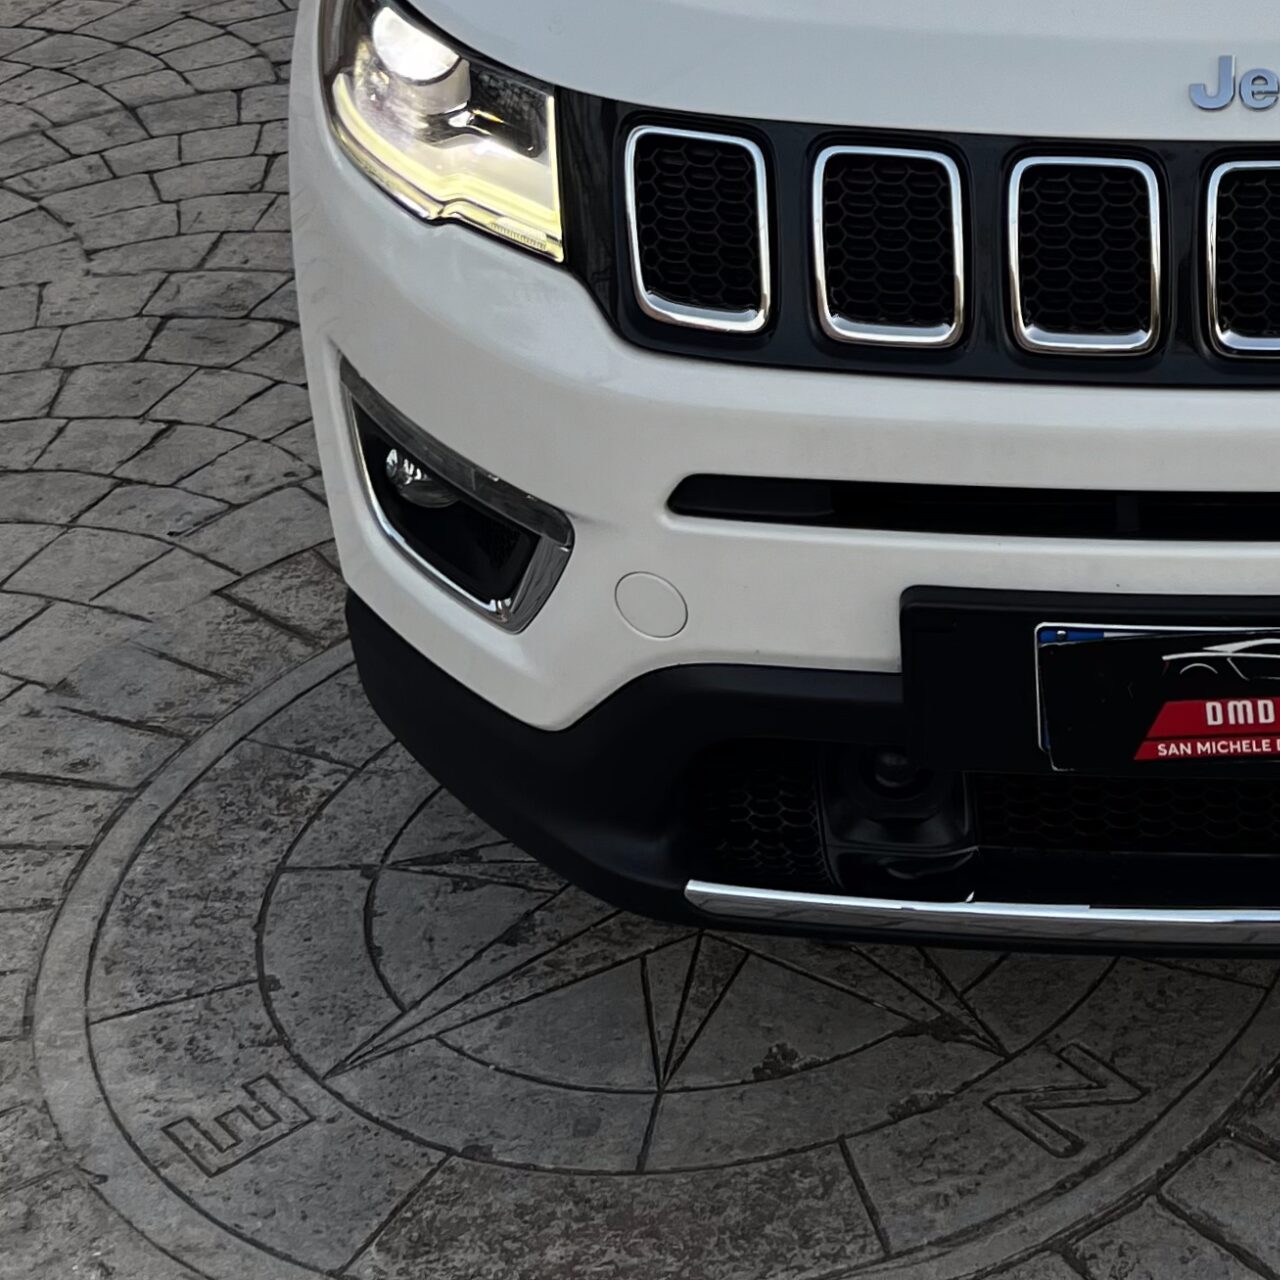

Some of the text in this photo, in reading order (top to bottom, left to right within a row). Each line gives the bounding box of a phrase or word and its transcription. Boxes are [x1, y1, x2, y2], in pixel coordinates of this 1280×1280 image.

[1205, 699, 1276, 726] DMD
[1157, 741, 1192, 758] SAN
[1196, 738, 1272, 756] MICHELE
